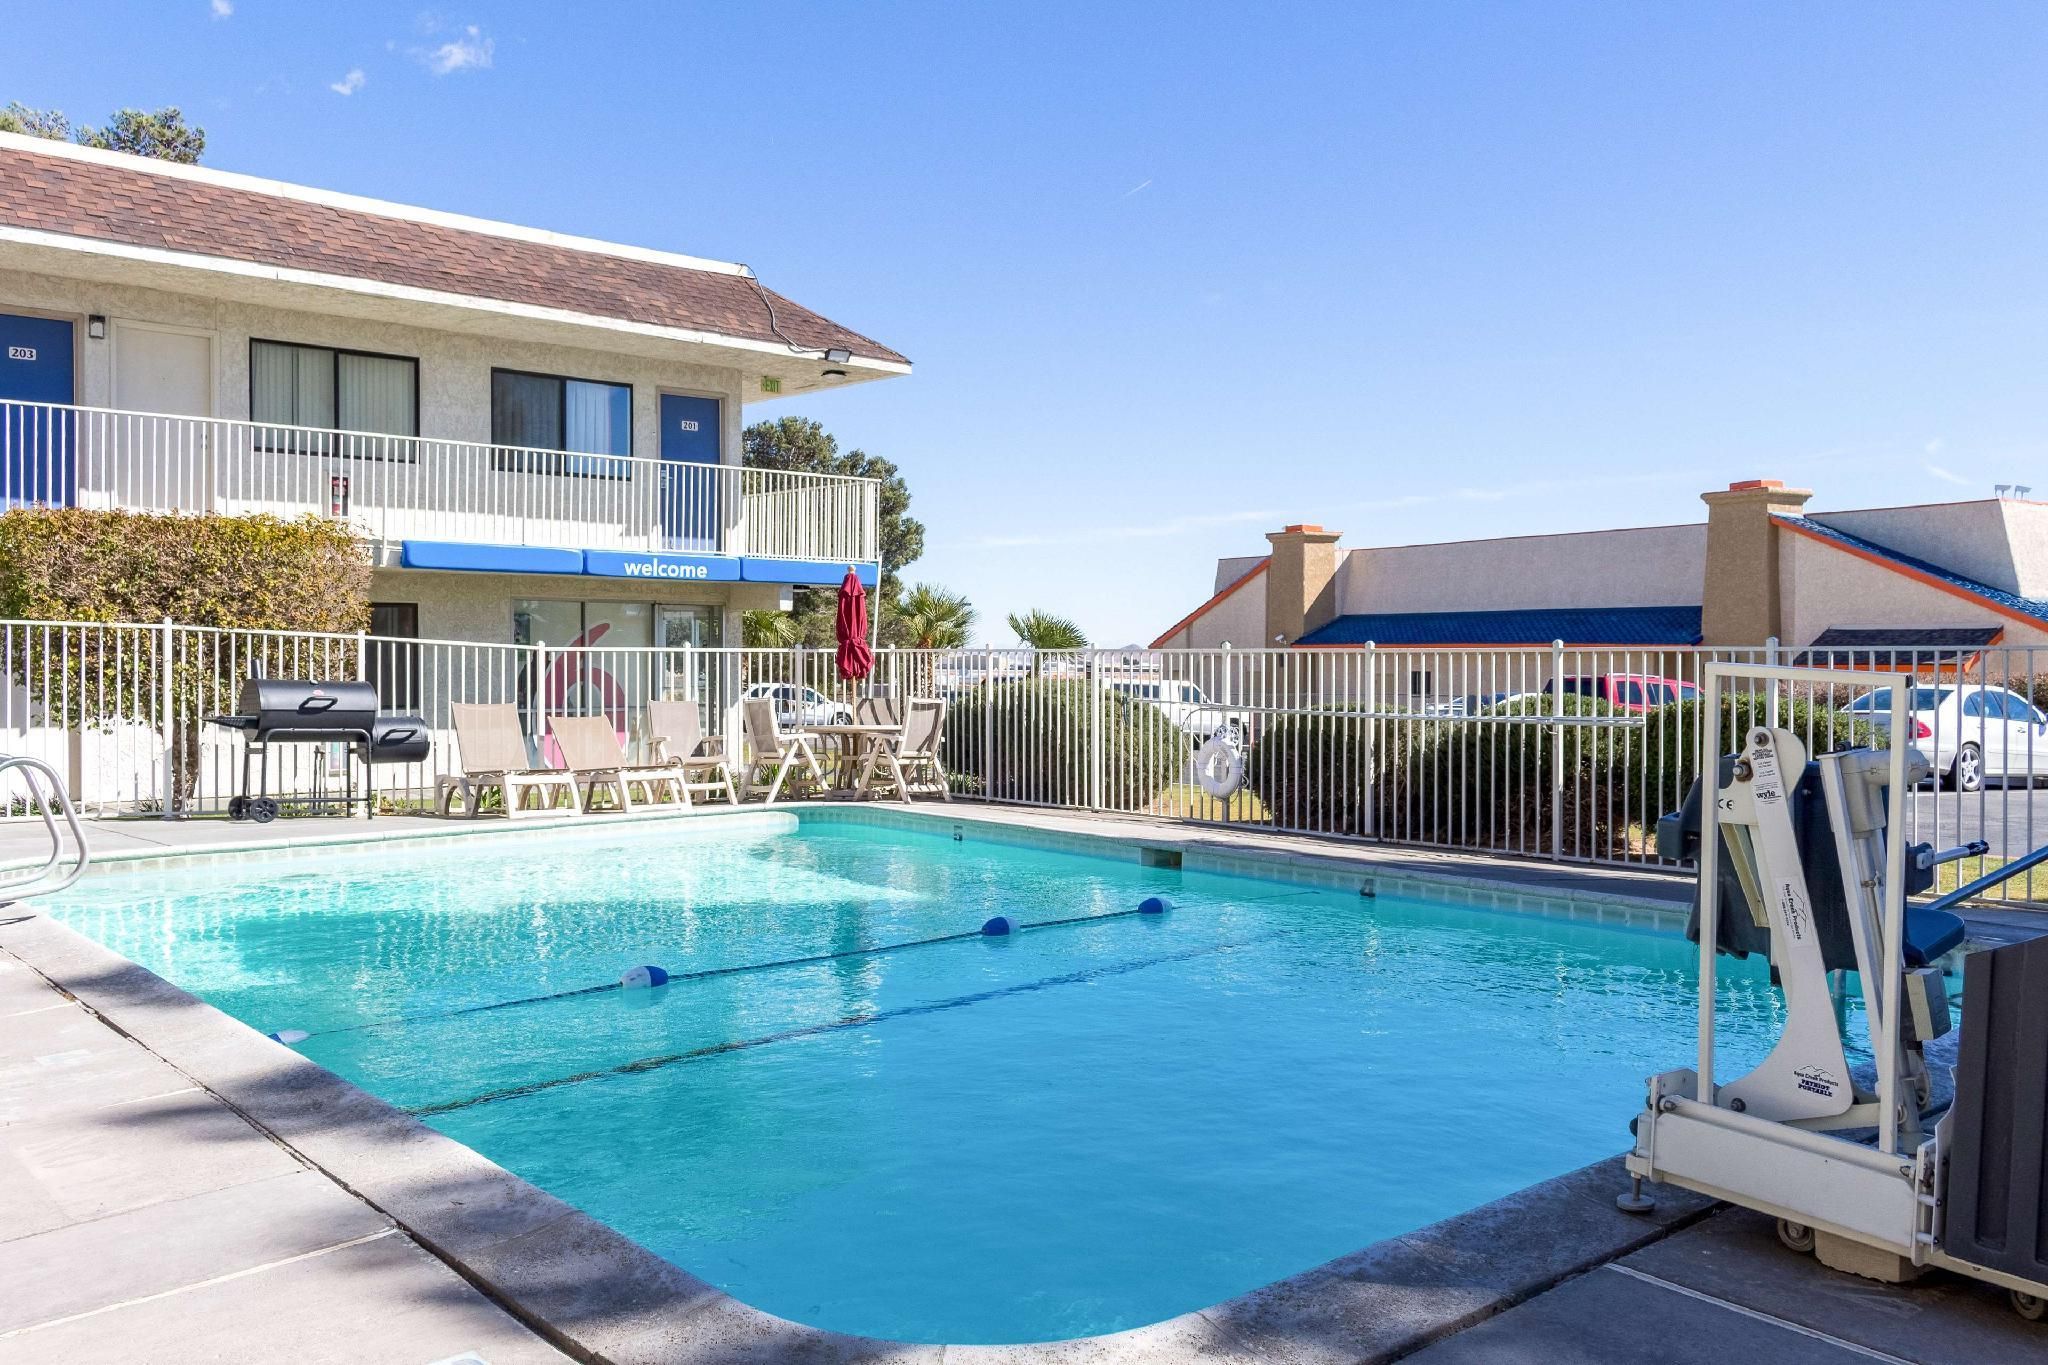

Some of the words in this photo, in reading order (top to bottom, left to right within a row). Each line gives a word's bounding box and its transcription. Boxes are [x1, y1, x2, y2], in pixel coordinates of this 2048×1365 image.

[11, 348, 34, 359] 203
[765, 379, 781, 393] EXIT
[683, 421, 696, 430] 201
[623, 557, 709, 578] welcome
[1756, 790, 1776, 799] wyle
[1798, 1083, 1832, 1097] PORTABLE
